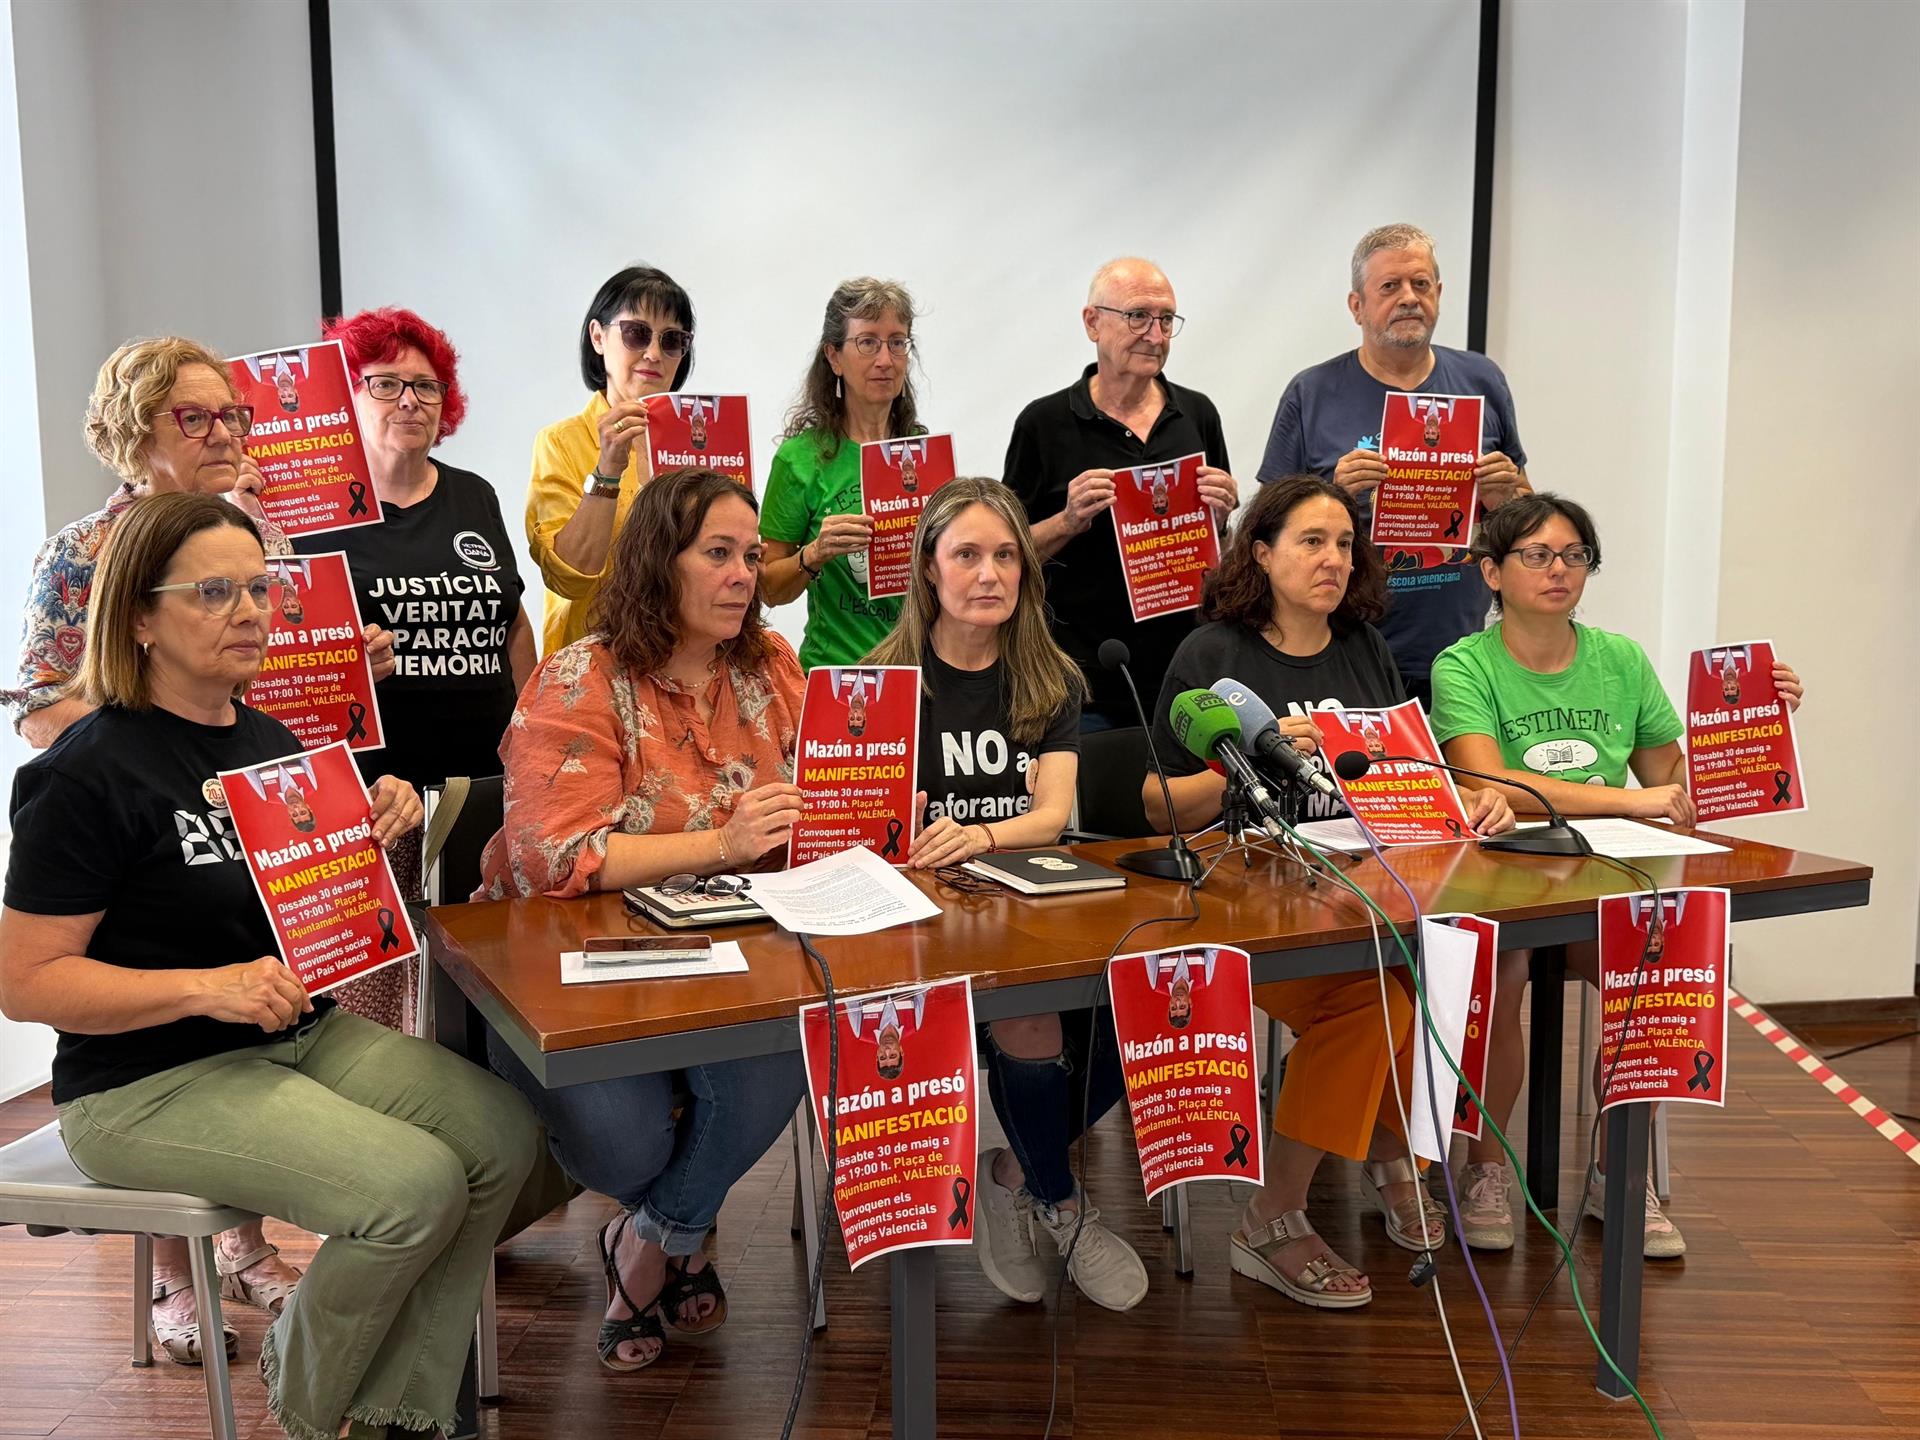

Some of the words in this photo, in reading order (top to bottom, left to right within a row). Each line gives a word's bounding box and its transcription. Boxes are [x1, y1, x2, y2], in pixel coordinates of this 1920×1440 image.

[293, 418, 303, 430] a
[305, 407, 349, 433] presó
[247, 429, 354, 459] MANIFESTACIÓ
[658, 450, 696, 466] Mazón
[700, 455, 706, 466] a
[710, 452, 744, 469] presó
[1388, 447, 1427, 462] Mazón
[1430, 452, 1437, 462] a
[1440, 450, 1474, 466] presó
[1387, 468, 1472, 480] MANIFESTACIÓ
[870, 495, 909, 514] Mazón
[912, 497, 919, 507] a
[874, 515, 918, 532] MANIFE
[1121, 518, 1158, 537] Mazón
[1162, 519, 1169, 529] a
[1172, 507, 1205, 530] presó
[1125, 525, 1208, 555] MANIFESTACIÓ
[464, 549, 490, 557] DANA
[368, 571, 503, 598] JUSTÍCIA
[1417, 572, 1461, 585] valenciana
[380, 599, 501, 624] VERITAT
[267, 627, 295, 646] zón
[298, 630, 308, 643] a
[310, 621, 354, 646] presó
[393, 620, 508, 649] PARACIÓ
[260, 645, 358, 672] ANIFESTACIÓ
[1690, 708, 1730, 727] Mazón
[1733, 710, 1740, 721] a
[1743, 699, 1780, 723] presó
[1692, 720, 1783, 748] MANIFESTACIÓ
[805, 739, 851, 758] Mazón
[855, 744, 863, 757] a
[866, 737, 906, 761] presó
[941, 729, 1008, 776] NO
[1016, 751, 1030, 773] a
[1693, 751, 1724, 762] Dissabte
[1725, 748, 1734, 757] 30
[1735, 747, 1744, 755] de
[1745, 745, 1765, 753] maig
[805, 762, 905, 782] MANIFESTACIÓ
[1382, 763, 1393, 774] a
[1694, 764, 1705, 772] les
[1706, 760, 1726, 770] 19:00
[1735, 757, 1755, 765] Plaça
[1756, 754, 1766, 762] de
[1741, 762, 1782, 774] VALÈNCIA
[206, 788, 225, 800] 20:1
[802, 788, 839, 798] Dissabte
[841, 788, 852, 797] 30
[853, 788, 863, 796] de
[864, 787, 883, 797] maig
[1345, 774, 1442, 792] MANIFESTACIÓ
[1696, 784, 1734, 796] Convoquen
[1735, 781, 1747, 789] els
[803, 802, 814, 810] es
[821, 800, 840, 809] 19:00
[851, 799, 873, 809] Plaça
[874, 799, 884, 807] de
[1697, 793, 1736, 805] moviments
[1736, 789, 1765, 799] socials
[1698, 807, 1710, 815] del
[1710, 804, 1726, 813] País
[1726, 799, 1758, 810] Valencià
[857, 809, 896, 819] VALÈNCIA
[253, 840, 312, 871] Mazón
[313, 838, 326, 852] a
[326, 817, 371, 853] presó
[797, 840, 846, 849] moviments
[845, 838, 876, 848] socials
[798, 828, 846, 838] Convoquen
[847, 827, 861, 836] els
[797, 852, 810, 860] del
[267, 845, 376, 896] MANIFESTACIÓ
[277, 895, 318, 914] Dissabte
[318, 888, 331, 900] 30
[332, 886, 343, 896] de
[344, 879, 364, 891] maig
[343, 898, 382, 918] VALÈNCIA
[282, 916, 298, 927] les
[298, 904, 324, 921] 19:00
[334, 895, 356, 908] Plaça
[358, 891, 367, 900] de
[293, 935, 340, 958] Convoquen
[341, 929, 354, 940] els
[297, 948, 344, 971] moviments
[344, 936, 372, 952] socials
[302, 971, 316, 984] del
[316, 964, 335, 978] País
[334, 950, 368, 970] Valencià
[1605, 967, 1647, 990] Mazón
[1651, 970, 1660, 983] a
[1664, 964, 1716, 987] presó
[1124, 1034, 1174, 1064] Mazón
[1179, 1035, 1189, 1051] a
[1194, 1032, 1247, 1054] presó
[891, 1087, 902, 1104] a
[908, 1068, 965, 1106] presó
[1128, 1060, 1248, 1092] MANIFESTACIÓ
[1165, 1088, 1177, 1099] 30
[1179, 1086, 1192, 1096] de
[1194, 1084, 1222, 1096] maig
[1142, 1104, 1165, 1120] 19:00
[1178, 1099, 1208, 1110] Plaça
[1209, 1097, 1224, 1107] de
[835, 1150, 874, 1169] issabte
[877, 1144, 891, 1157] 30
[894, 1142, 908, 1153] de
[910, 1136, 940, 1150] maig
[942, 1137, 950, 1146] a
[849, 1162, 878, 1179] 19:00
[894, 1155, 925, 1168] Plaça
[928, 1151, 943, 1162] de
[903, 1163, 962, 1181] VALÈNCIA
[841, 1198, 891, 1222] Convoquen
[893, 1192, 912, 1204] els
[845, 1212, 893, 1237] moviments
[895, 1203, 937, 1219] socials
[848, 1238, 858, 1253] del
[858, 1231, 877, 1246] País
[878, 1219, 927, 1237] Valencià
